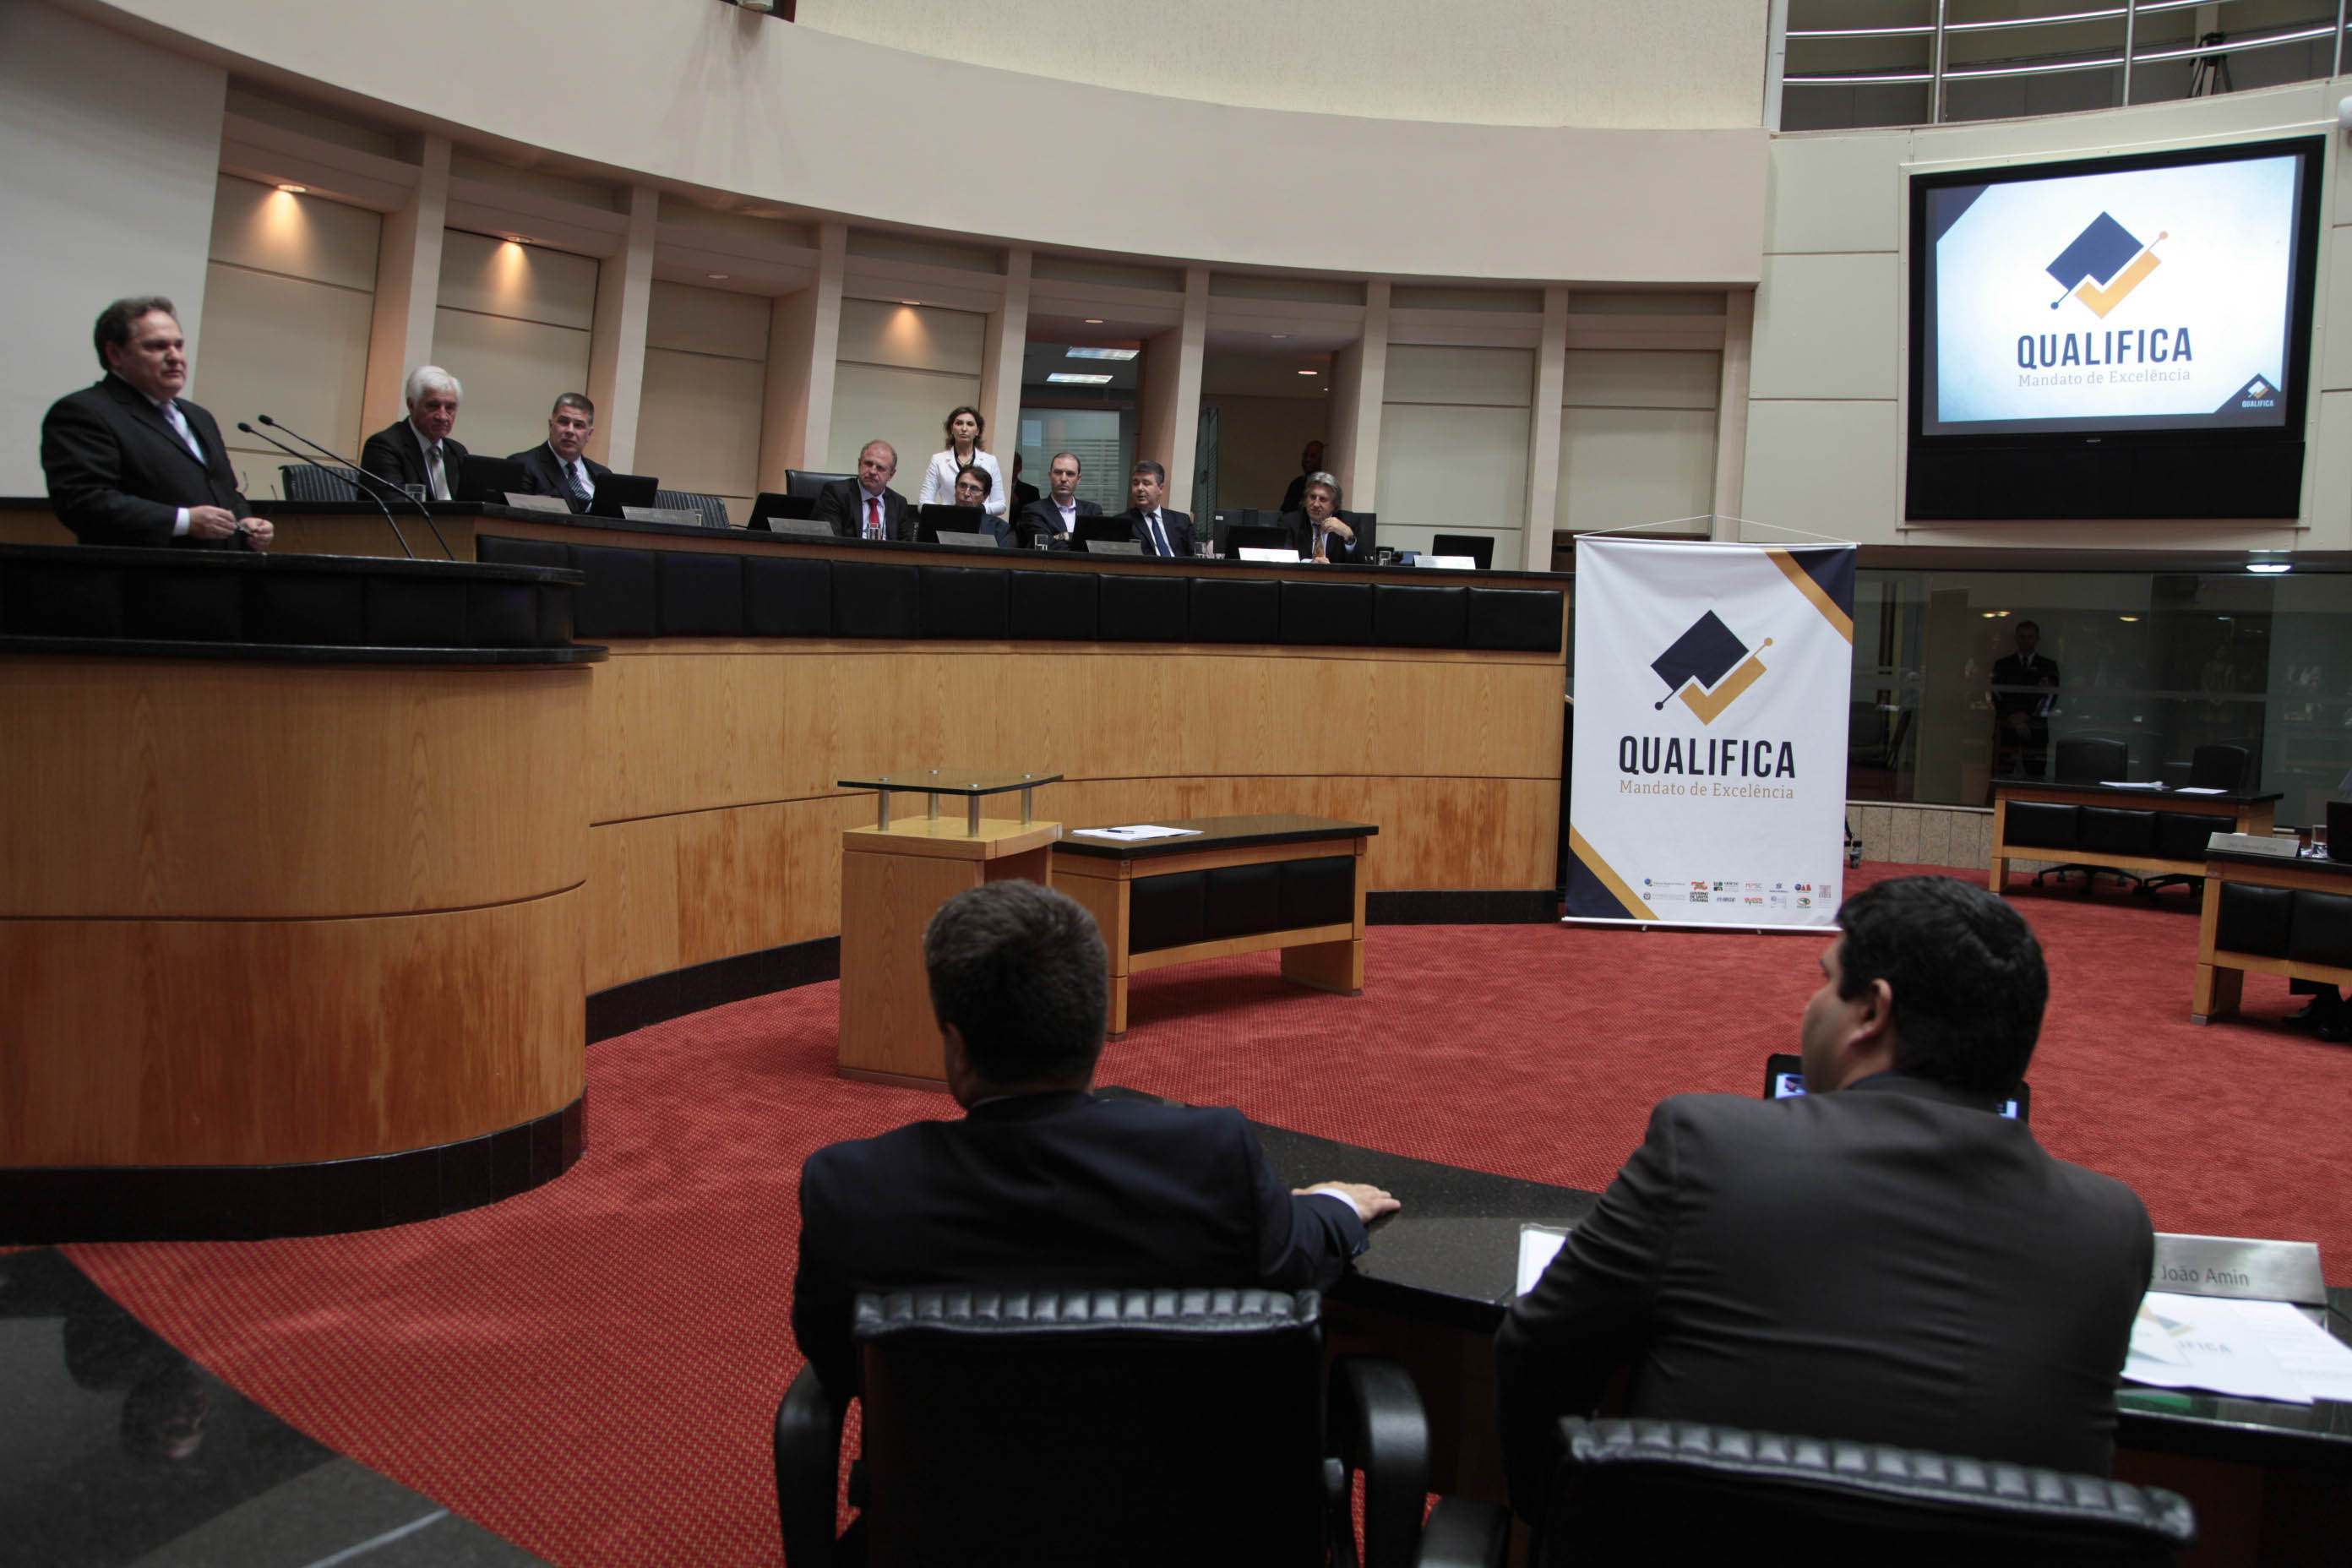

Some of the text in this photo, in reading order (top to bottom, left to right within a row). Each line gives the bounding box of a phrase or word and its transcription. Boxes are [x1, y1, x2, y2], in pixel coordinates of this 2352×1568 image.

[2017, 327, 2192, 369] QUALIFICA
[2018, 368, 2191, 387] Mandato de Excelência
[2241, 400, 2273, 408] QUALIFICA
[1619, 735, 1795, 778] QUALIFICA
[1620, 780, 1794, 799] Mandato de Excelência
[2161, 1264, 2249, 1286] João Amin
